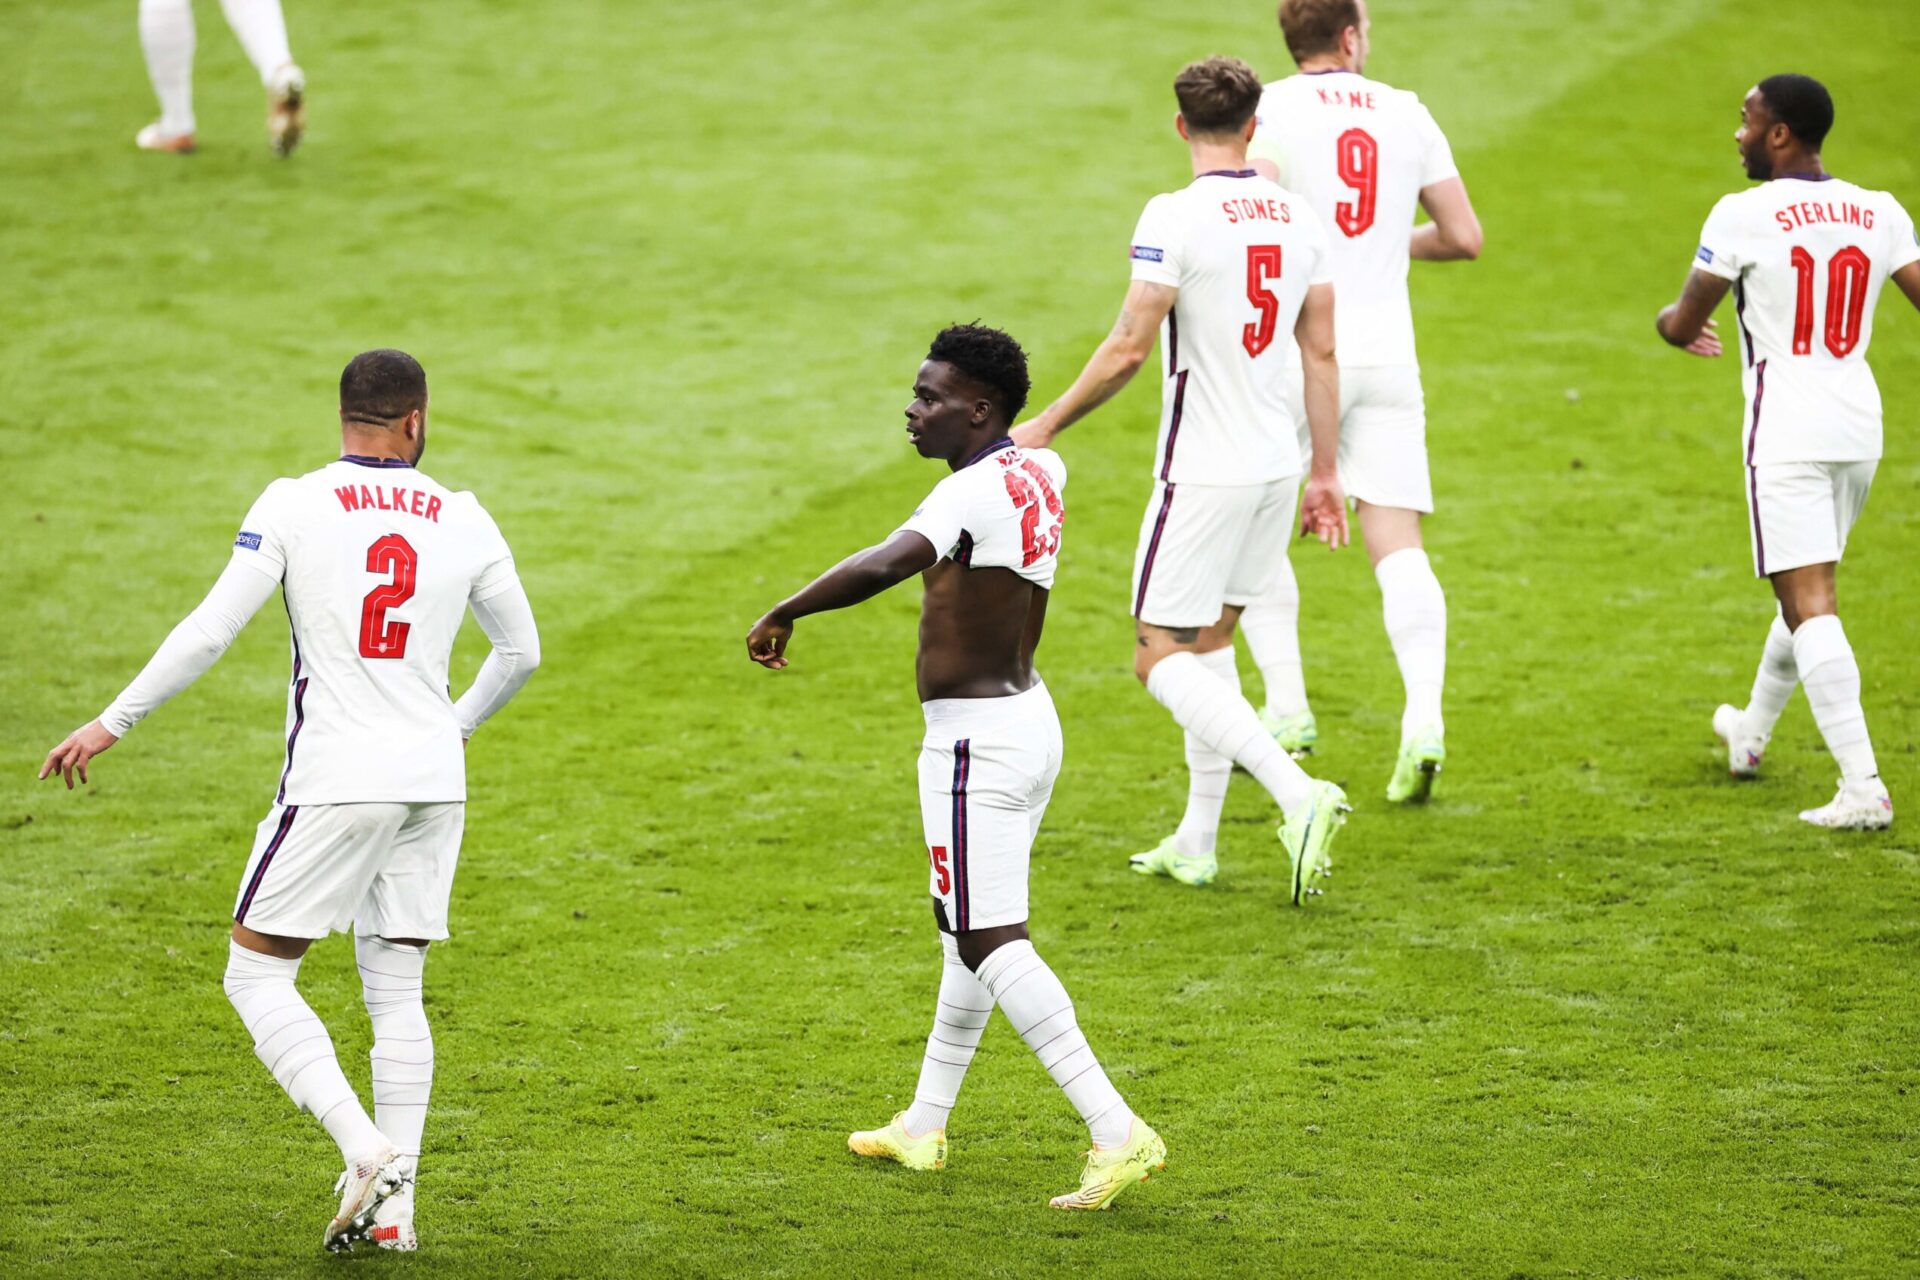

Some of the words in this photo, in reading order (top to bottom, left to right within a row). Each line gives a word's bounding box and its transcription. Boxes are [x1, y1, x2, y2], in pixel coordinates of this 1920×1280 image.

[1222, 198, 1291, 224] STONES
[1335, 127, 1378, 239] 9
[1775, 202, 1874, 232] STERLING
[1242, 244, 1282, 359] 5
[1790, 245, 1871, 359] 10
[334, 484, 443, 524] WALKER
[358, 532, 418, 660] 2
[928, 845, 951, 896] 5
